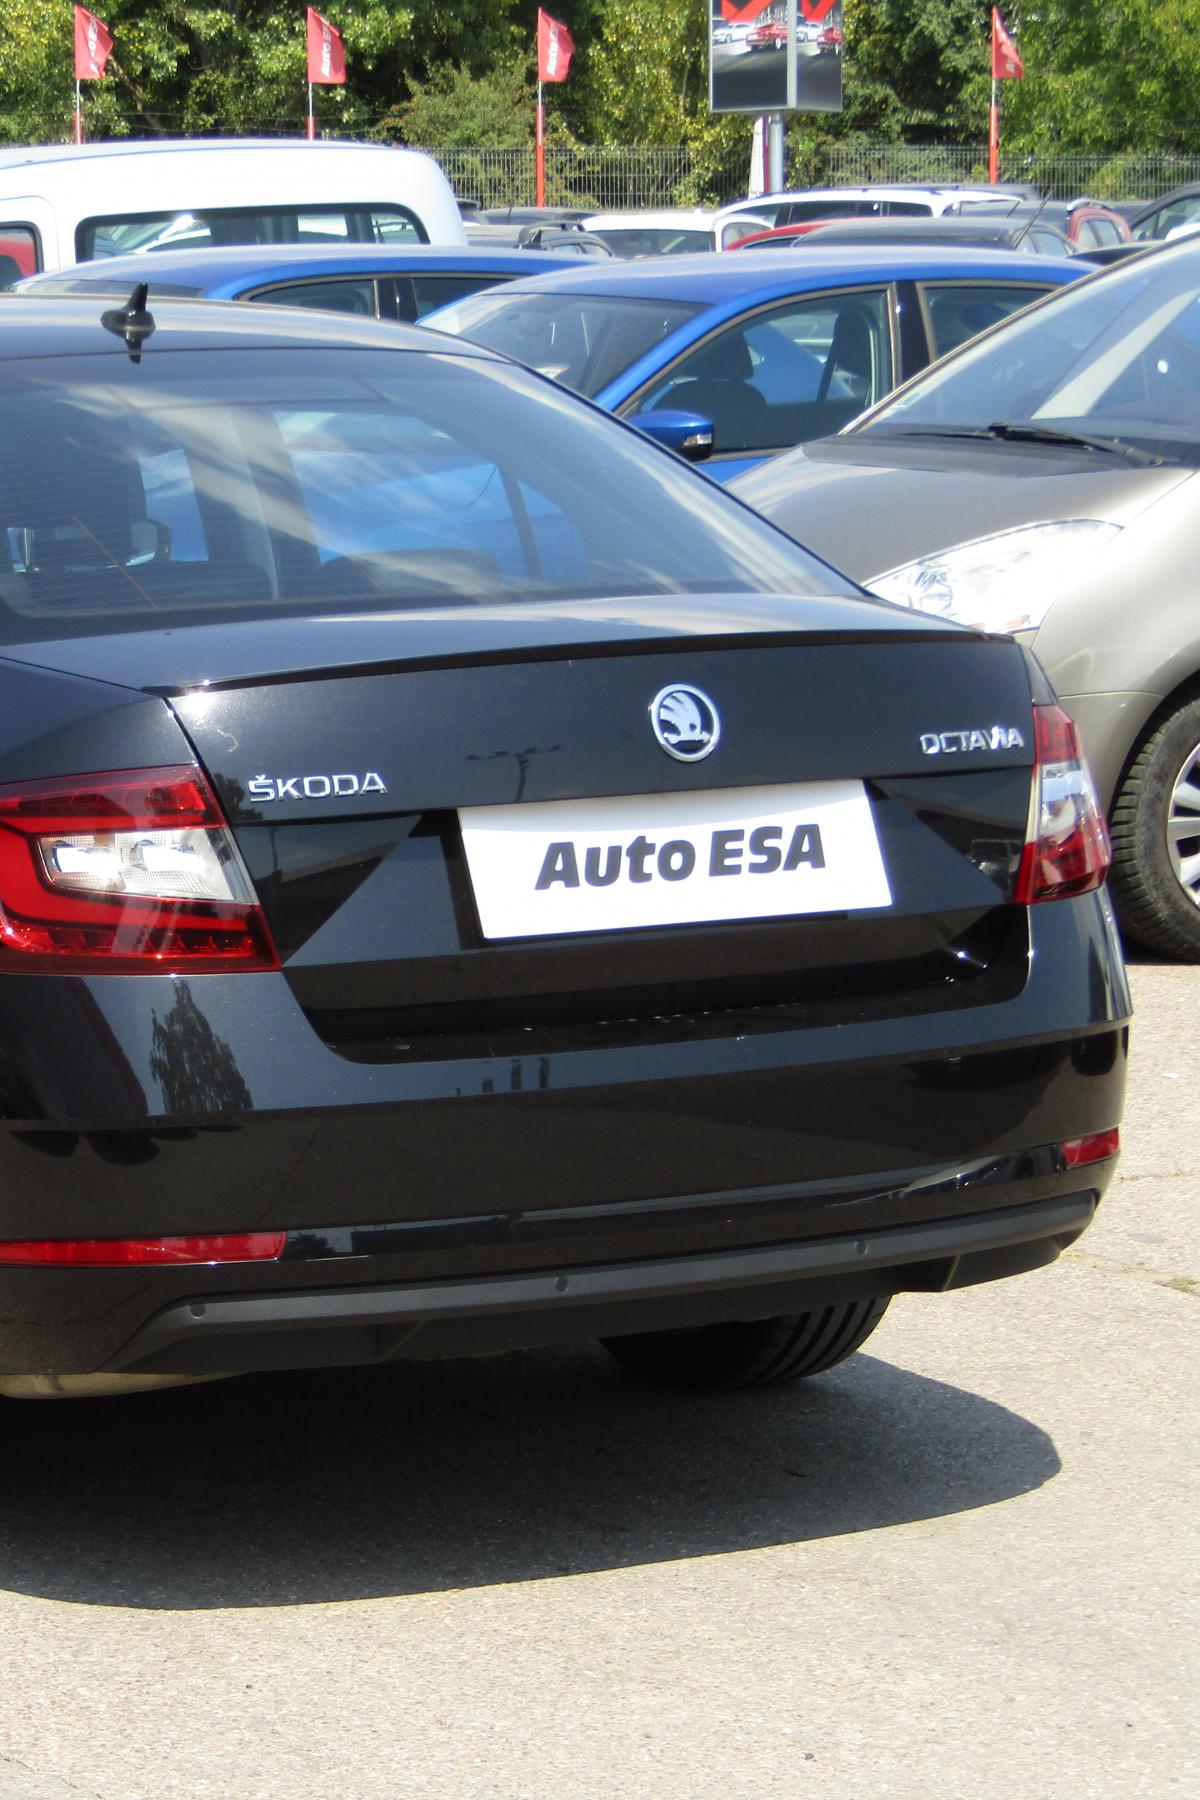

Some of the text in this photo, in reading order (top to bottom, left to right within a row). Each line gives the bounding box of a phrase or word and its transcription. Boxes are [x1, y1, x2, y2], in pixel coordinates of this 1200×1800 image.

[919, 725, 1025, 755] OCTAVIA
[248, 772, 389, 803] ŠKODA
[534, 823, 826, 891] Auto ESA
